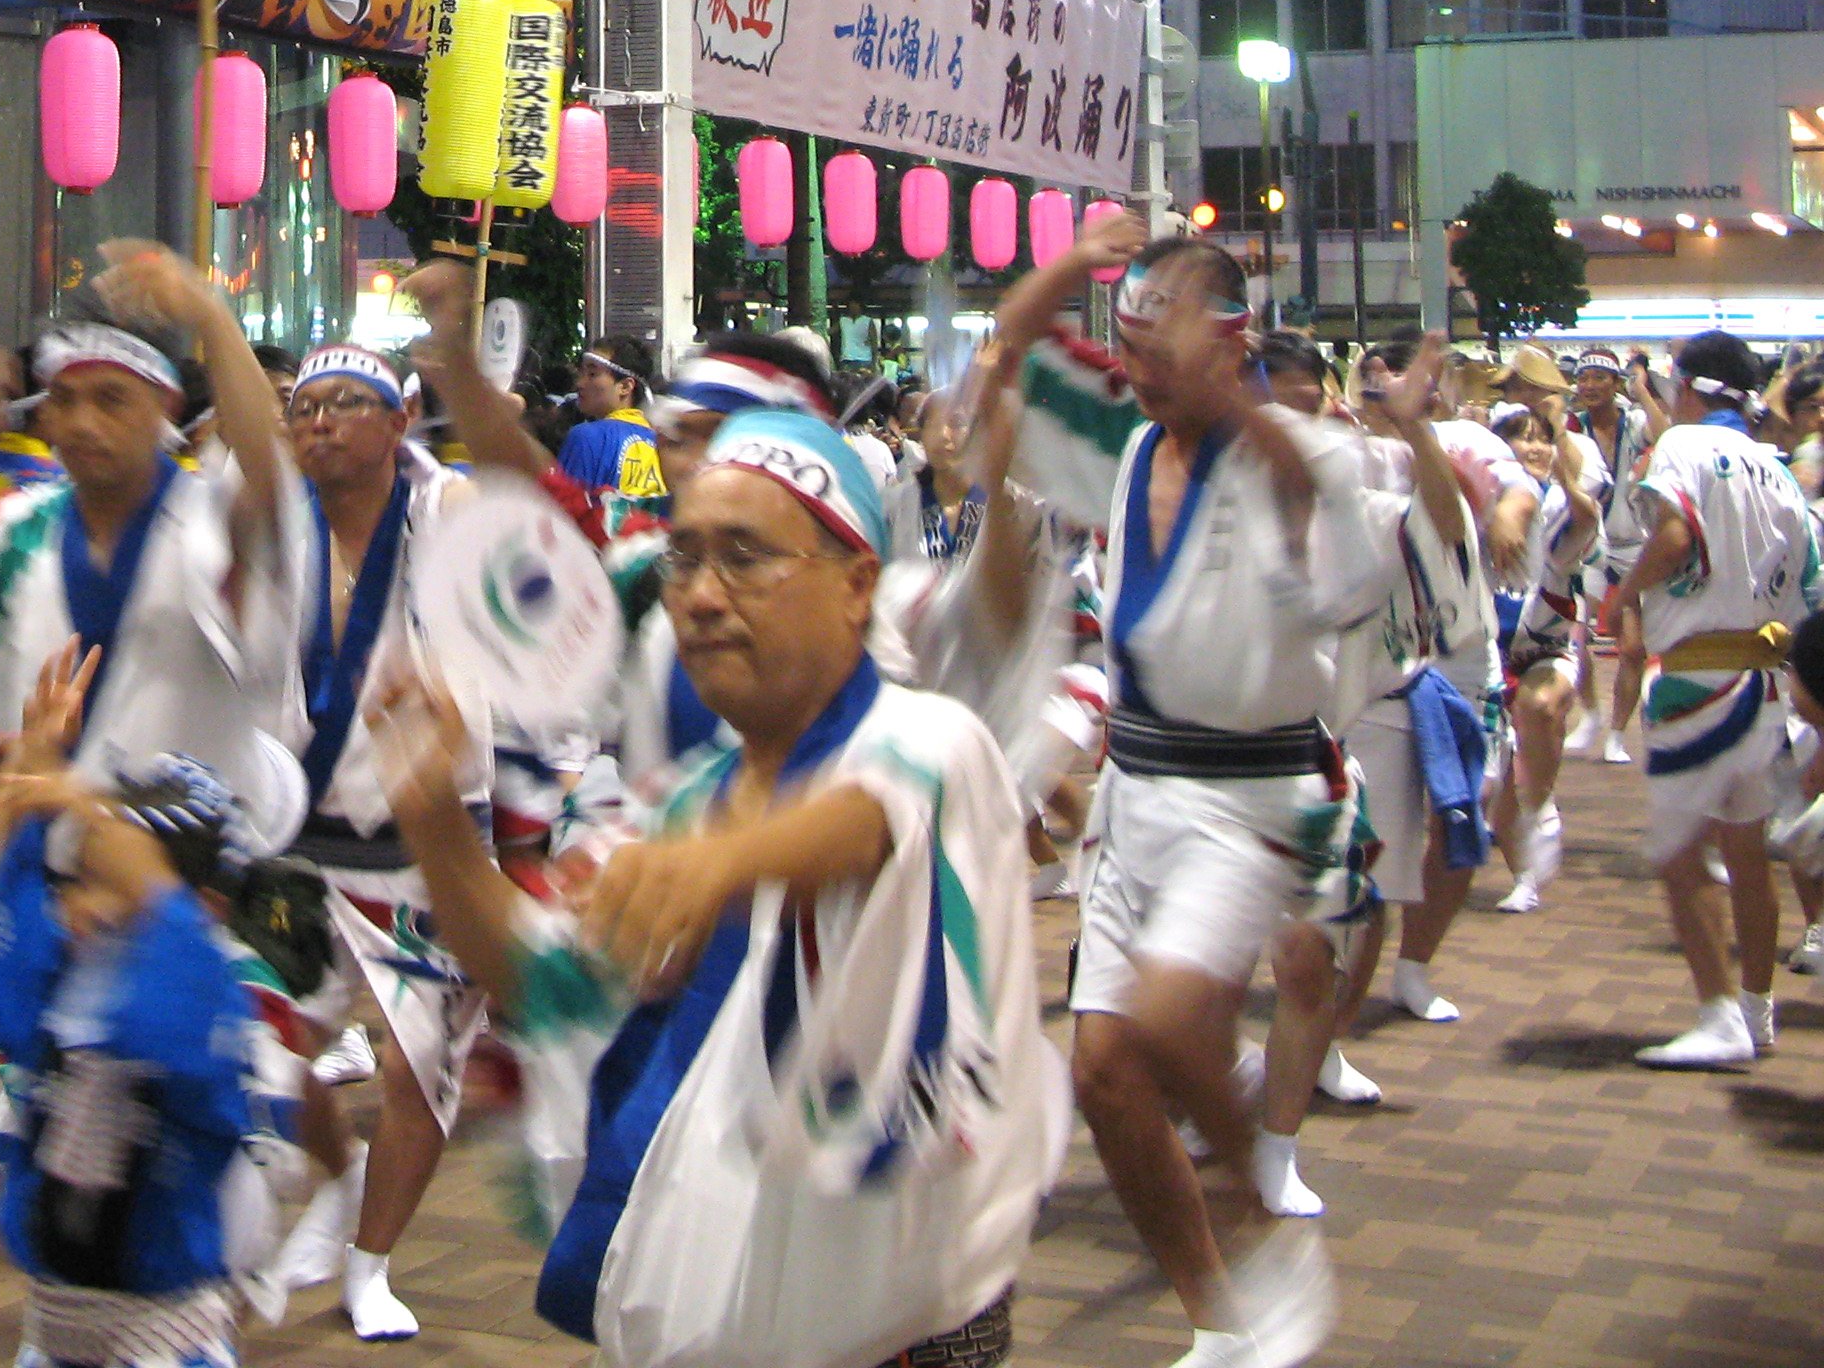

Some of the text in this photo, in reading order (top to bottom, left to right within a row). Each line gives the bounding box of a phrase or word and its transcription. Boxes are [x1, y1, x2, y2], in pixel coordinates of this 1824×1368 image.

[834, 2, 964, 91] 一緒に踊れる
[504, 14, 553, 190] 国際交流協会
[999, 52, 1132, 161] 阿波踊り
[1596, 184, 1741, 201] NISHISHINMACHI
